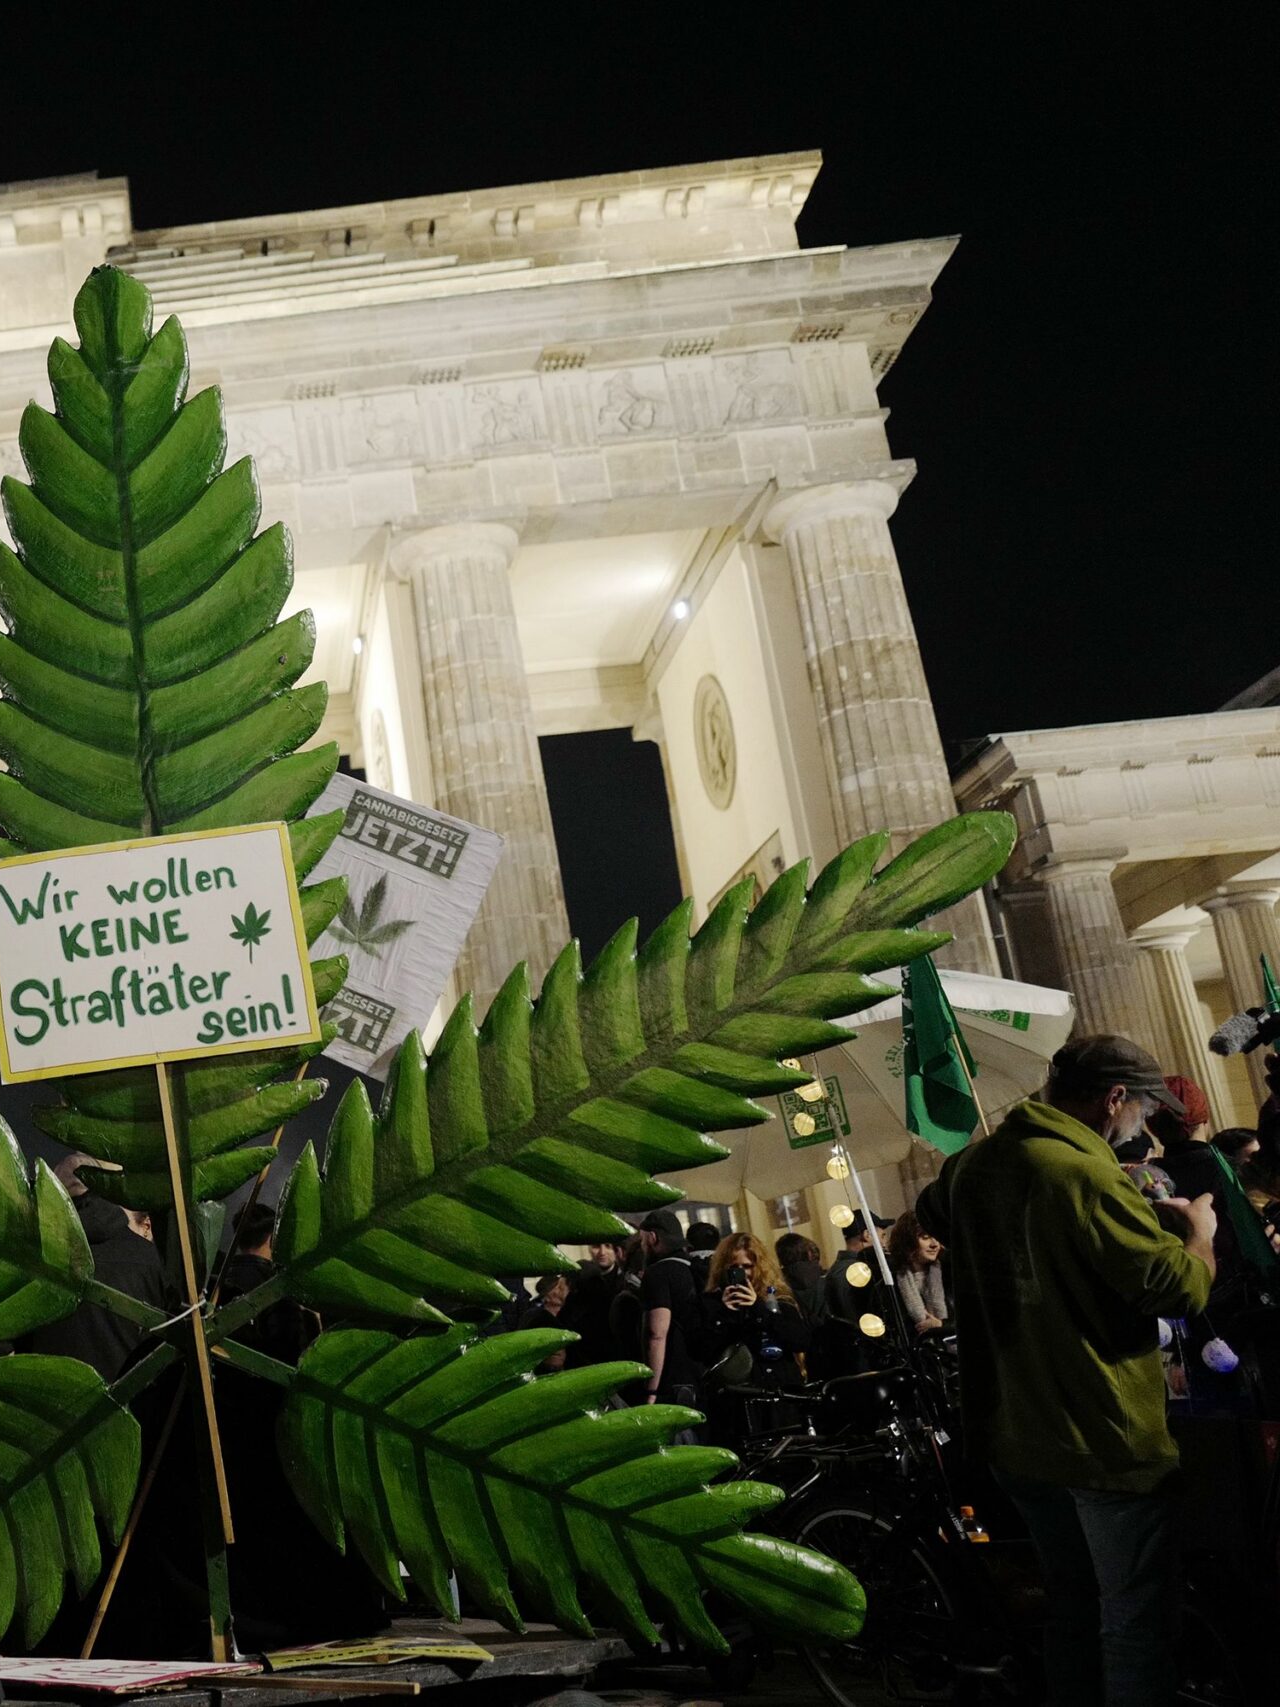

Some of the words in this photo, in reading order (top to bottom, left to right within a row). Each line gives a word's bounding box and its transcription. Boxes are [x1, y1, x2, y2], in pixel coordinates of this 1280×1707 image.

[341, 812, 457, 874] JETZT!
[355, 794, 465, 845] CANNABISGESETZ
[106, 857, 238, 905] wollen
[59, 909, 189, 962] KEINE
[10, 962, 231, 1046] Straftäter
[196, 973, 297, 1044] sein!
[319, 1001, 383, 1050] ZT!
[336, 988, 392, 1020] SGESETZ
